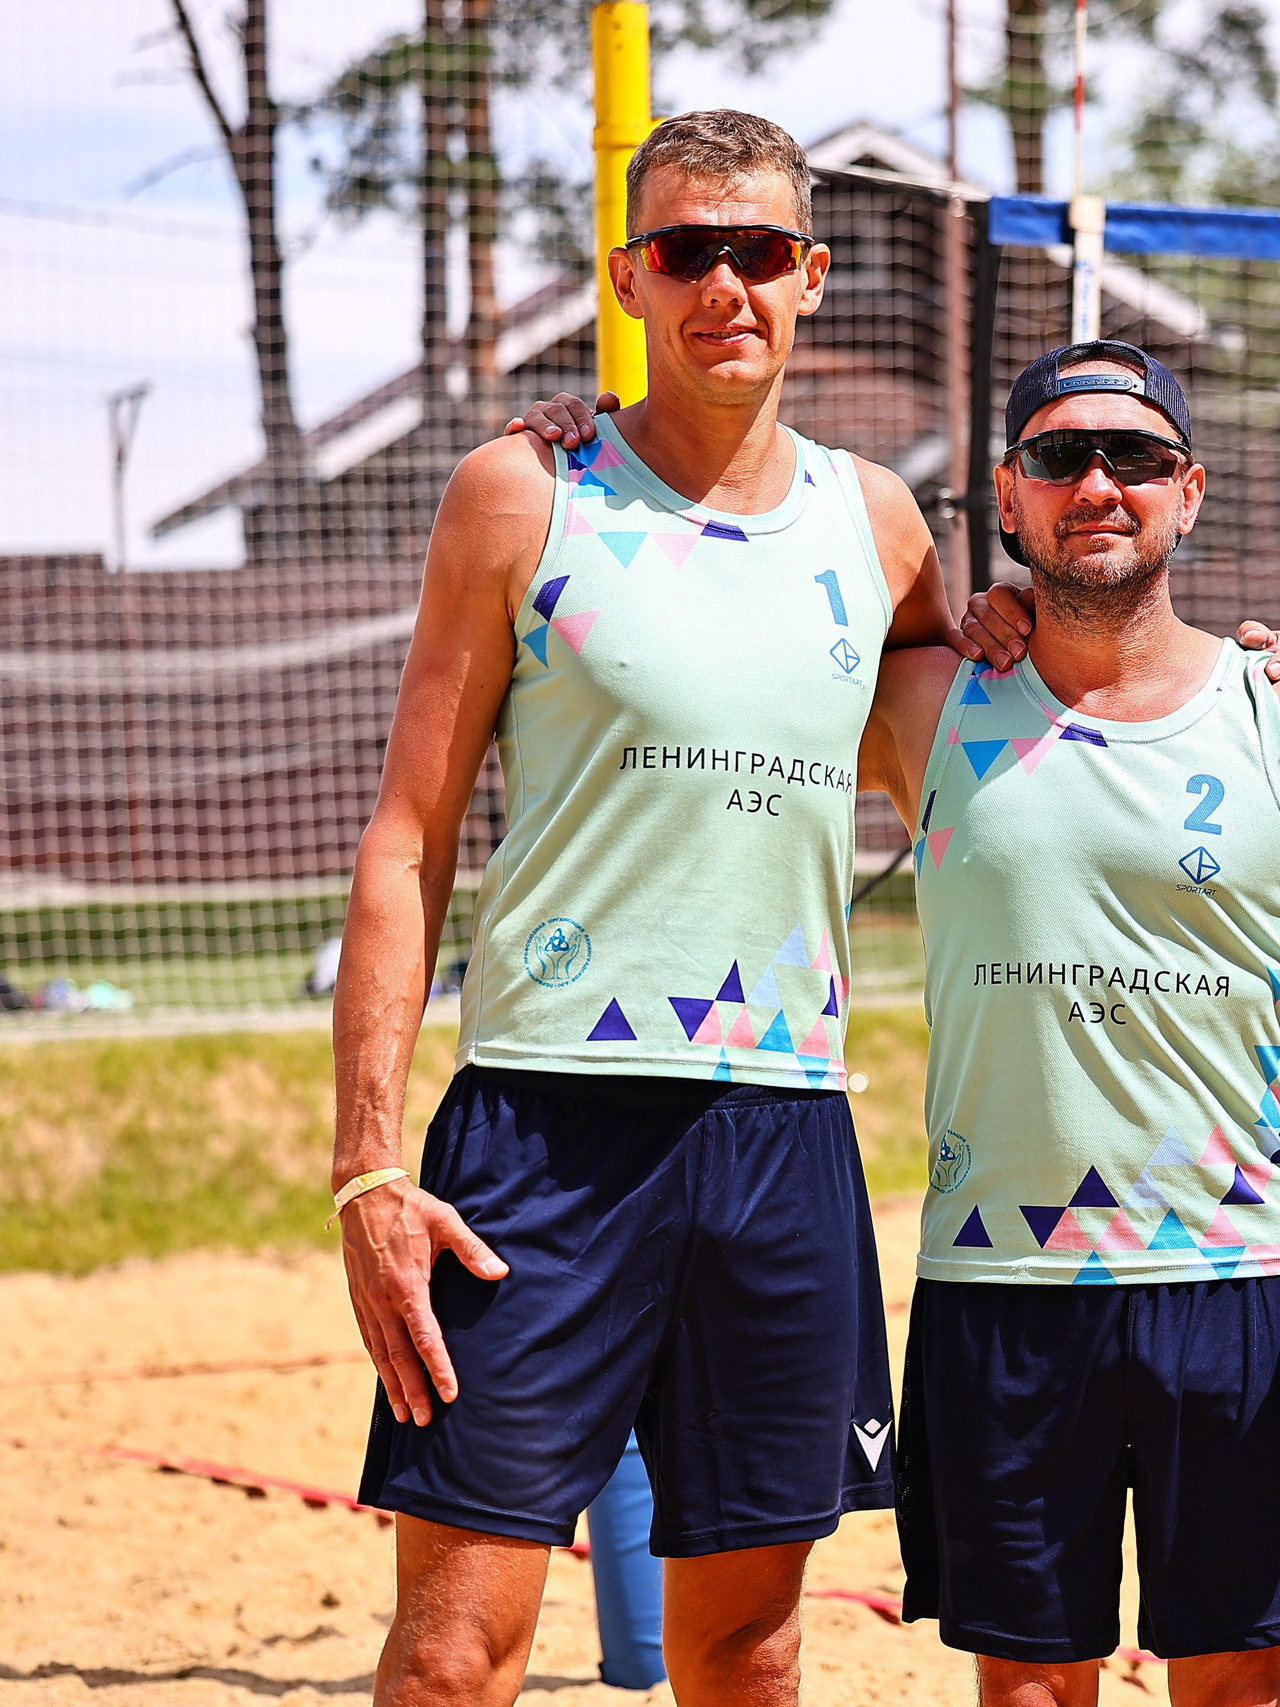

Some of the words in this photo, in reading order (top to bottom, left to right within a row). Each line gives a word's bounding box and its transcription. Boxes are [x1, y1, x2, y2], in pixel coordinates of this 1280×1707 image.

[814, 569, 848, 627] 1
[619, 746, 852, 796] ЛЕНИНГРАДСКАЯ
[726, 788, 782, 817] АЭС
[1183, 773, 1226, 836] 2
[1175, 883, 1217, 897] SPORTART
[973, 962, 1231, 998] ЛЕНИНГРАДСКАЯ
[1068, 1001, 1128, 1026] АЭС
